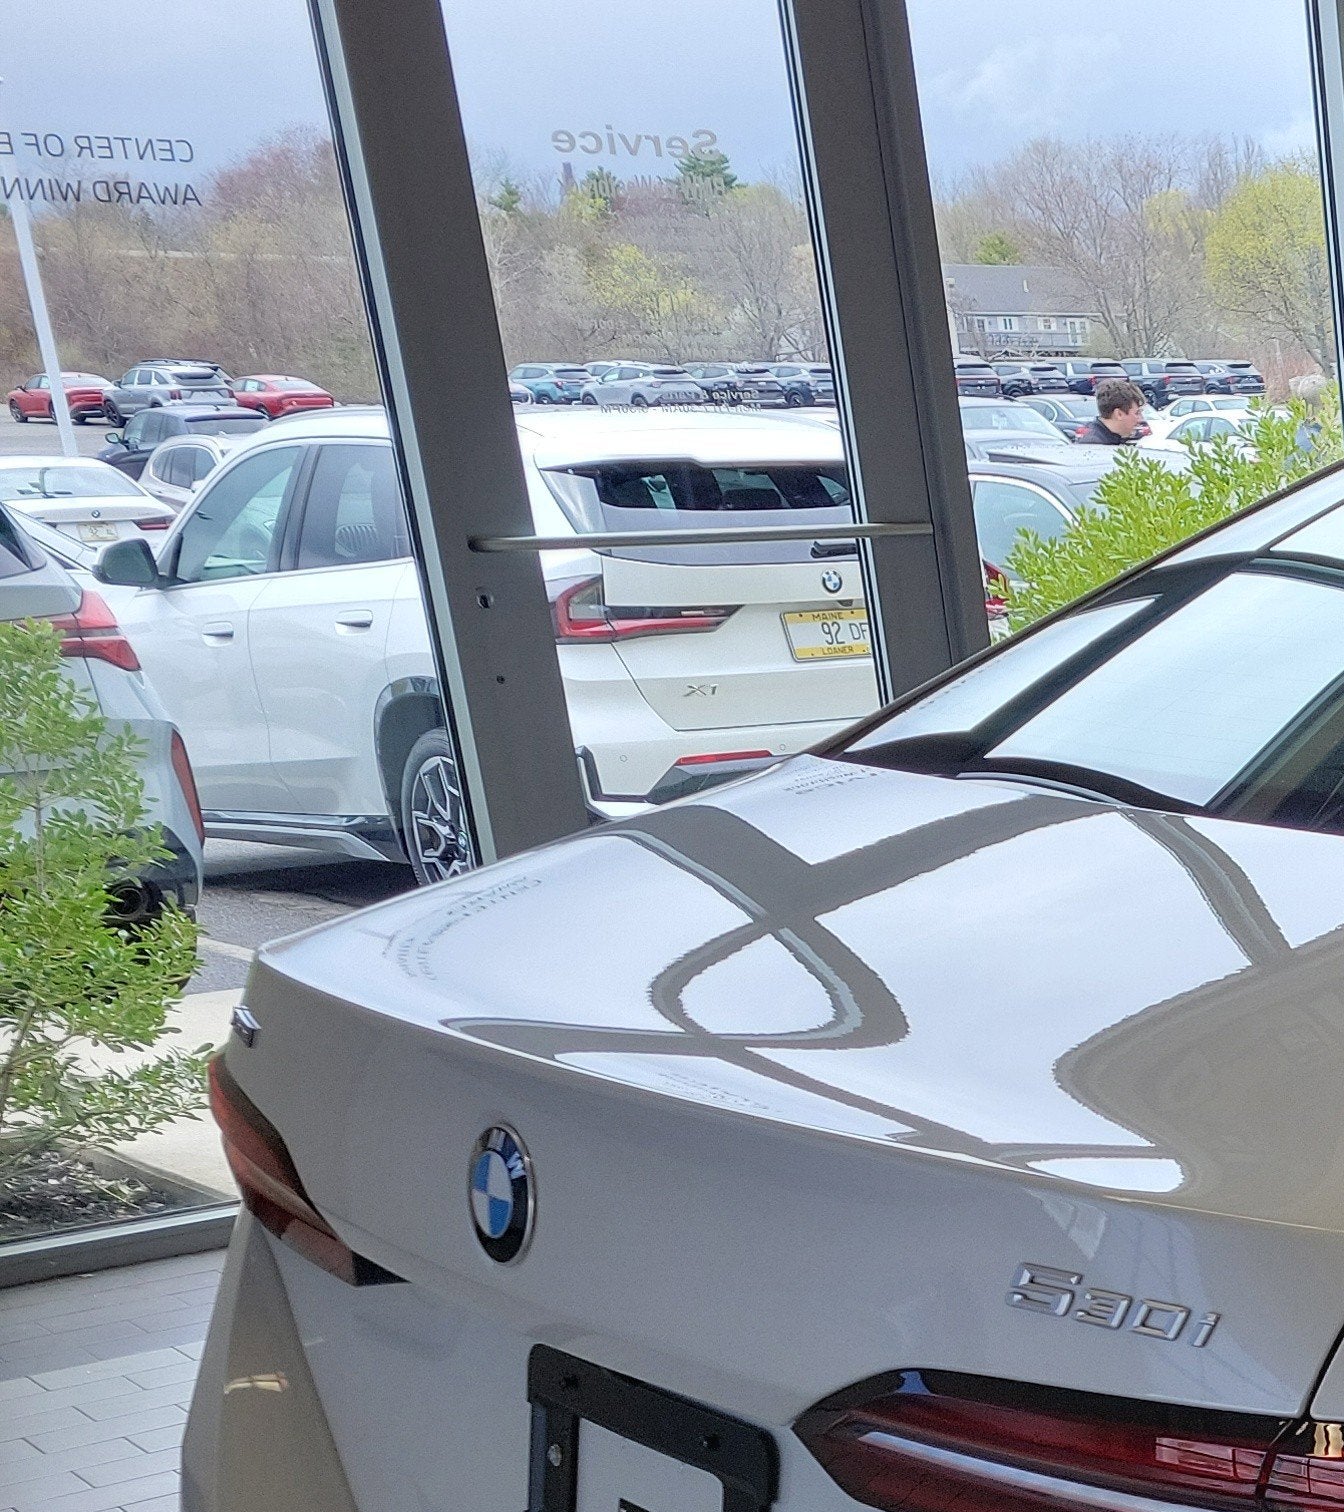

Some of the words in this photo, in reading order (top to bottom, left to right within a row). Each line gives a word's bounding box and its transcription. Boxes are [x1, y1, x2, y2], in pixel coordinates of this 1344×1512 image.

[811, 611, 845, 621] MAINE
[820, 621, 846, 646] 92
[821, 645, 854, 656] LOANER
[682, 683, 719, 698] X1
[1005, 1260, 1223, 1349] 530i
